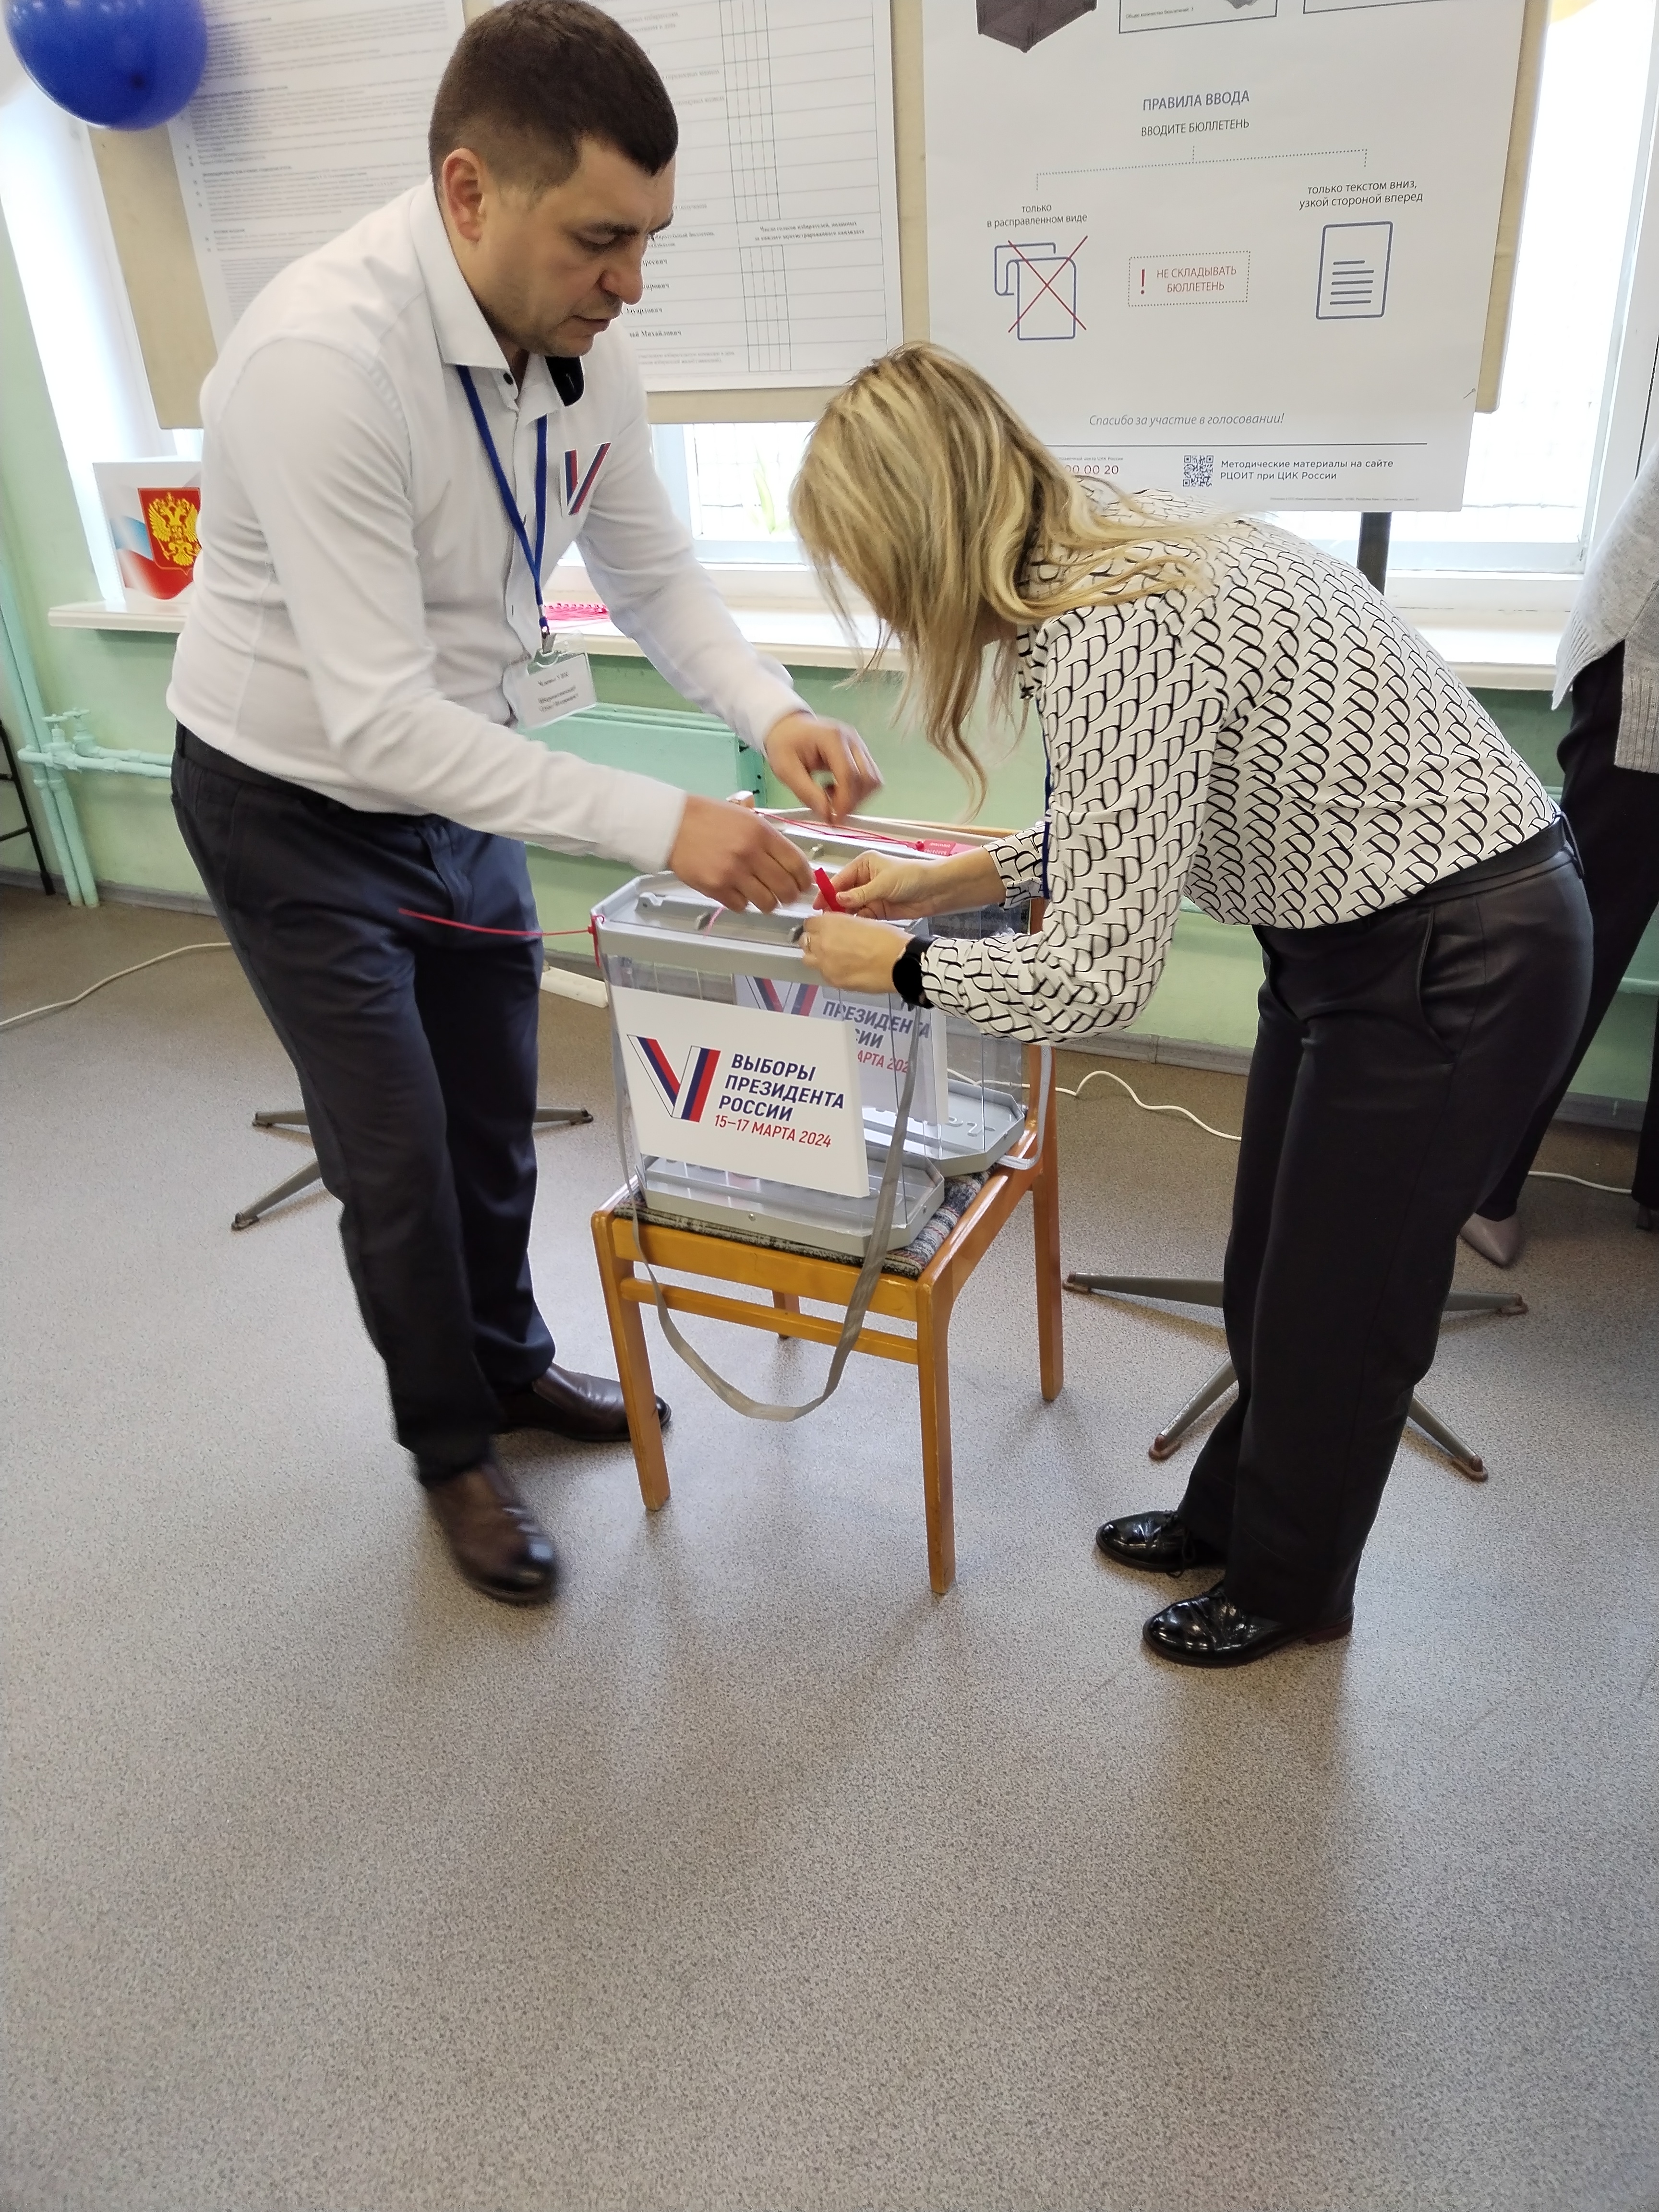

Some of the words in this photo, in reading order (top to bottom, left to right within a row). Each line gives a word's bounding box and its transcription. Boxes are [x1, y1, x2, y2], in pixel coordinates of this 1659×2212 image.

[1143, 94, 1202, 110] ПРАВИЛА
[1205, 90, 1250, 106] ВВОДА
[1142, 123, 1186, 137] ВВОДИТЕ
[1189, 119, 1249, 132] БЮЛЛЕТЕНЬ
[1308, 185, 1343, 194] только
[1346, 182, 1387, 192] текстом
[1390, 180, 1417, 189] вниз,
[1022, 204, 1052, 213] только
[1299, 197, 1328, 211] узкой
[1332, 193, 1382, 207] стороной
[1384, 193, 1423, 204] вперед
[994, 216, 1063, 229] расправленном
[1066, 214, 1087, 224] виде
[1156, 269, 1169, 279] НЕ
[1171, 265, 1237, 278] СКЛАДЫВАТЬ
[1167, 281, 1225, 293] БЮЛЛЕТЕНЬ
[1090, 414, 1133, 425] Спасибо
[1135, 417, 1148, 425] за
[1149, 416, 1197, 427] участие
[1199, 416, 1205, 425] в
[1207, 413, 1285, 425] голосовании!
[1084, 465, 1100, 474] 00
[1104, 465, 1119, 474] 20
[1221, 460, 1290, 469] Методические
[1365, 459, 1394, 468] сайте
[1220, 471, 1254, 480] РЦОИТ
[1278, 471, 1298, 480] ЦИК
[1301, 471, 1337, 480] России
[822, 1001, 930, 1039] ПРЕЗИДЕНА
[731, 1053, 816, 1081] ВЫБОРЫ
[857, 1050, 885, 1068] АРТА
[887, 1058, 909, 1073] 202
[725, 1074, 844, 1109] ПРЕЗИДЕНТА
[719, 1095, 793, 1122] РОССИИ
[751, 1122, 795, 1142] МАРТА
[798, 1130, 831, 1148] 2024
